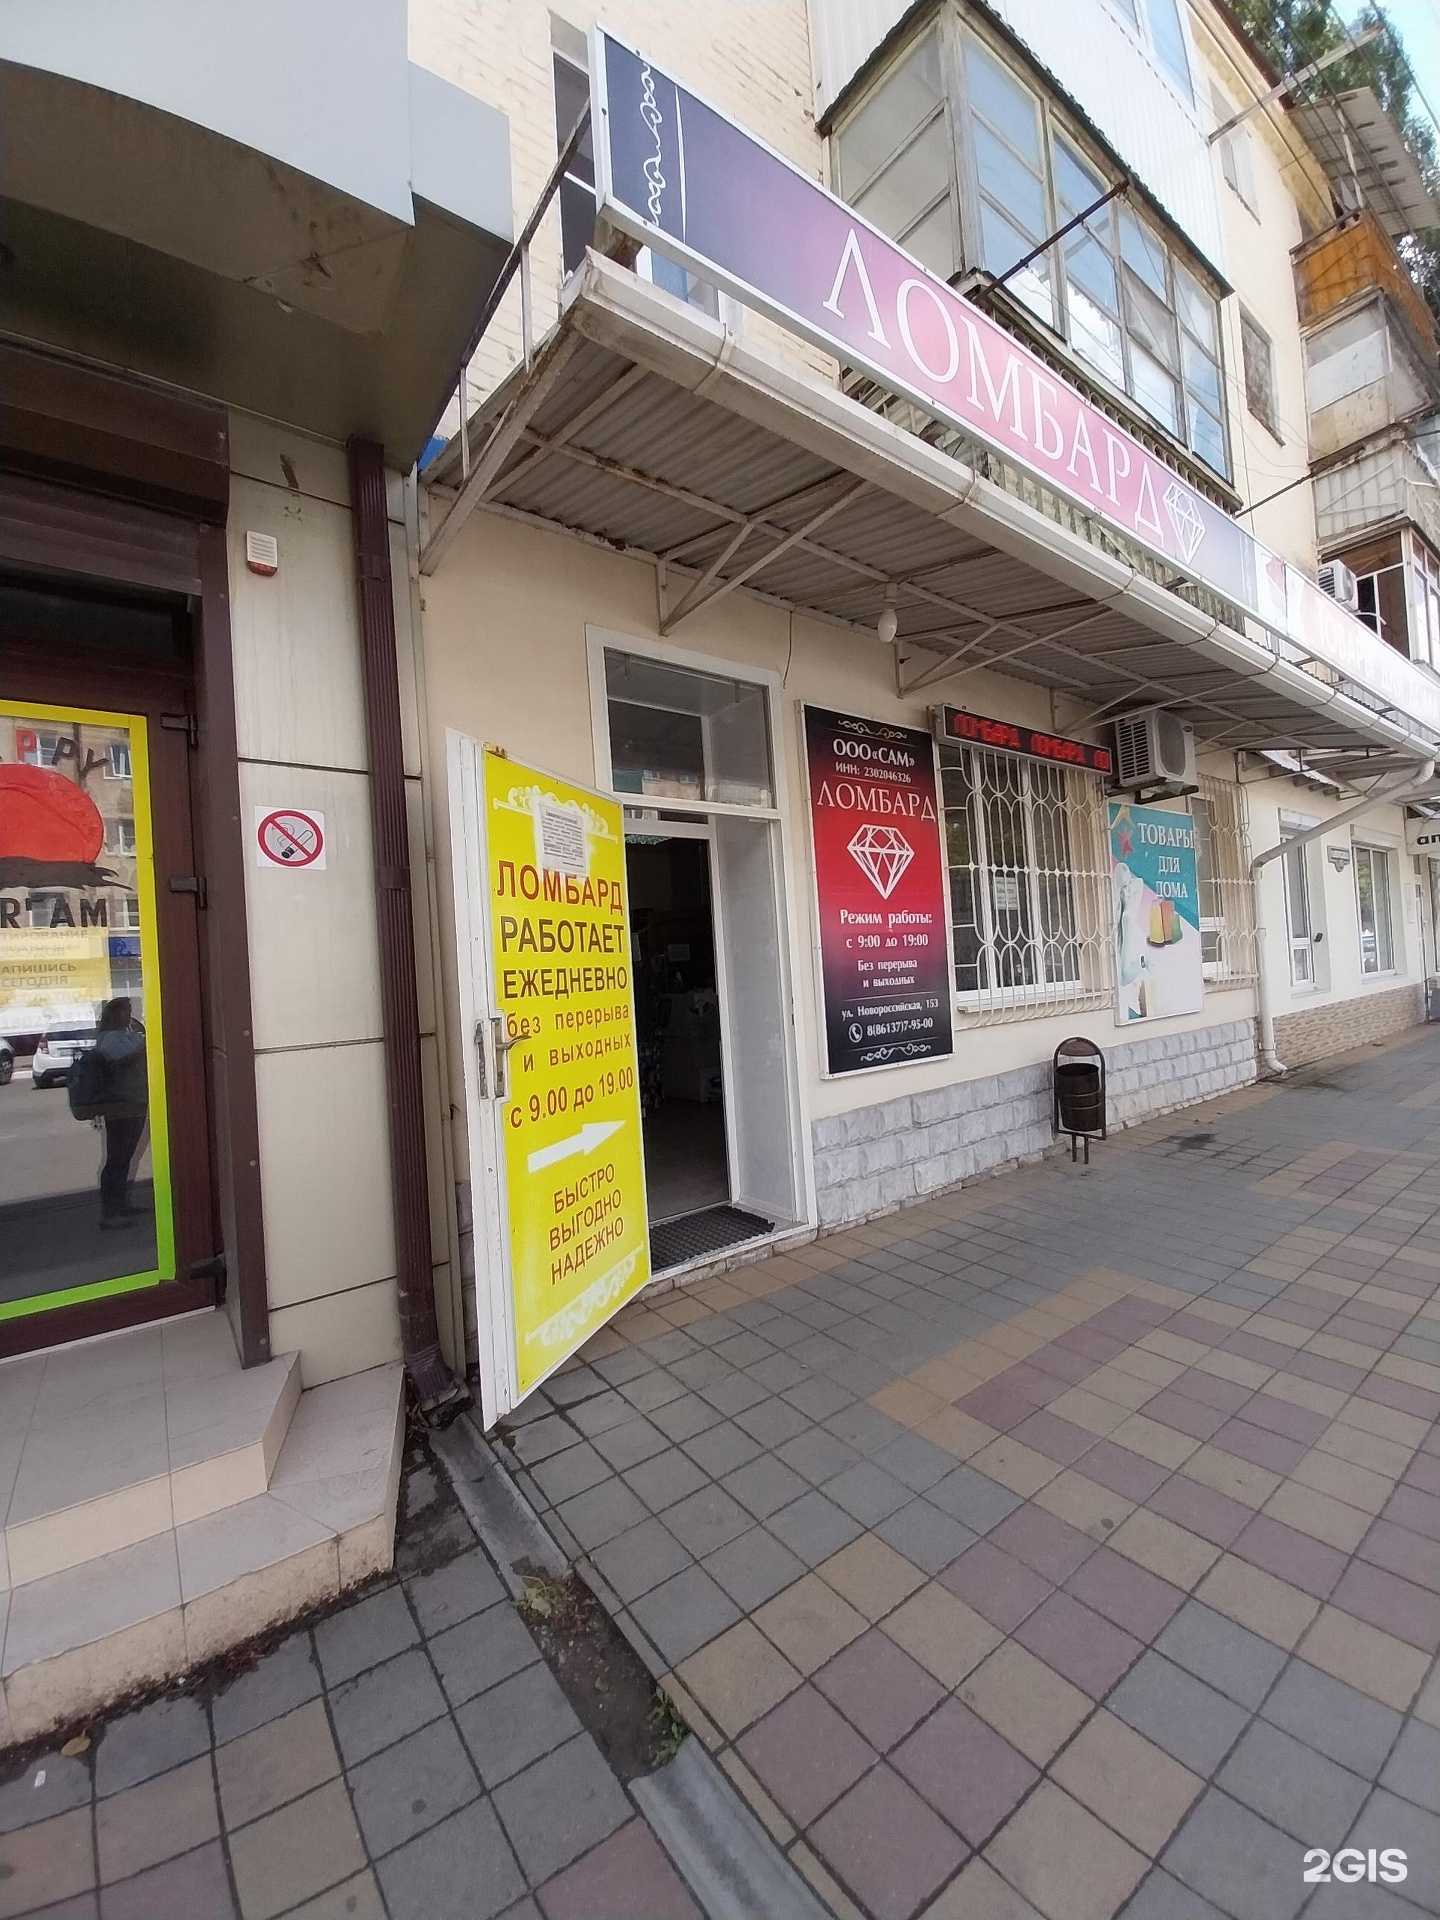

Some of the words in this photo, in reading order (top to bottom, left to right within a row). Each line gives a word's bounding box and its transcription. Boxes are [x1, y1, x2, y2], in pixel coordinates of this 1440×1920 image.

[823, 228, 1165, 549] ЛОМБАРД
[835, 762, 860, 776] ИНН:
[863, 766, 912, 784] 2302046326
[817, 781, 936, 822] ЛОМБАРД
[1136, 822, 1196, 849] ТОВАРЫ
[1158, 855, 1181, 873] ДЛЯ
[497, 860, 623, 916] ЛОМБАРД
[1155, 881, 1188, 899] ДОМА
[500, 915, 624, 953] РАБОТАЕТ
[839, 909, 882, 925] Режим
[888, 910, 932, 928] работы:
[857, 935, 880, 948] 9:00
[885, 937, 898, 947] до
[902, 933, 929, 947] 19:00
[857, 959, 874, 971] Без
[877, 959, 918, 972] перерыва
[863, 979, 870, 988] и
[873, 975, 915, 987] выходных
[503, 966, 628, 1000] ЕЖЕДНЕВНО
[506, 1012, 541, 1037] без
[554, 1004, 630, 1032] перерыва
[841, 1009, 854, 1021] ул.
[926, 998, 939, 1009] 153
[523, 1053, 534, 1072] и
[549, 1032, 632, 1066] выходных
[510, 1105, 523, 1129] с
[529, 1084, 568, 1121] 9.00
[573, 1083, 595, 1108] до
[599, 1066, 634, 1099] 19.00
[553, 1163, 616, 1215] БЫСТРО
[549, 1189, 622, 1252] ВЫГОДНО
[551, 1217, 625, 1286] НАДЕЖНО
